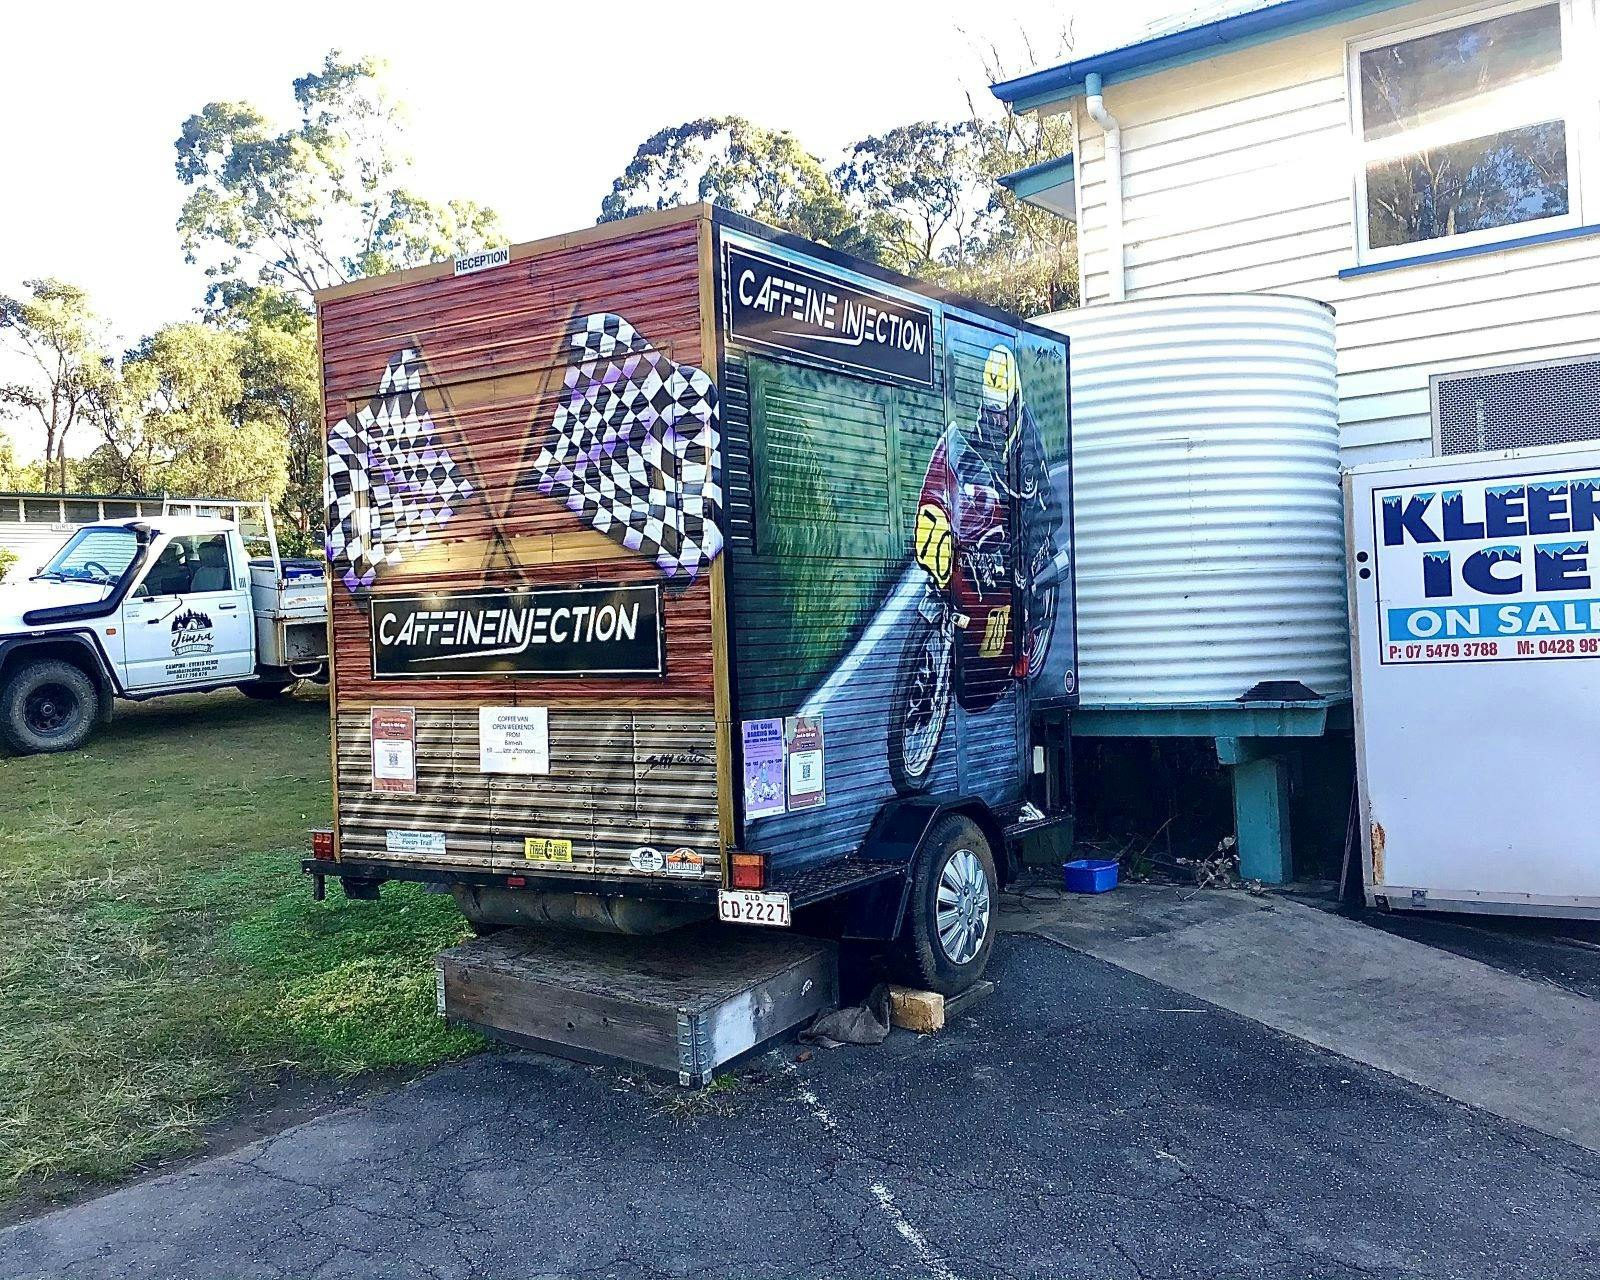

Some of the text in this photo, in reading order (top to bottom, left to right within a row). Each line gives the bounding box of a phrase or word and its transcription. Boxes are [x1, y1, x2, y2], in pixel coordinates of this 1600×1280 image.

[456, 250, 508, 272] RECEPTION
[738, 269, 927, 356] CAFFEINE INJECTION
[1423, 540, 1592, 599] ICE
[1407, 607, 1481, 638] ON
[1389, 638, 1600, 659] P: 07 5479 3788 M: 0428 98
[497, 715, 516, 723] COFFEE
